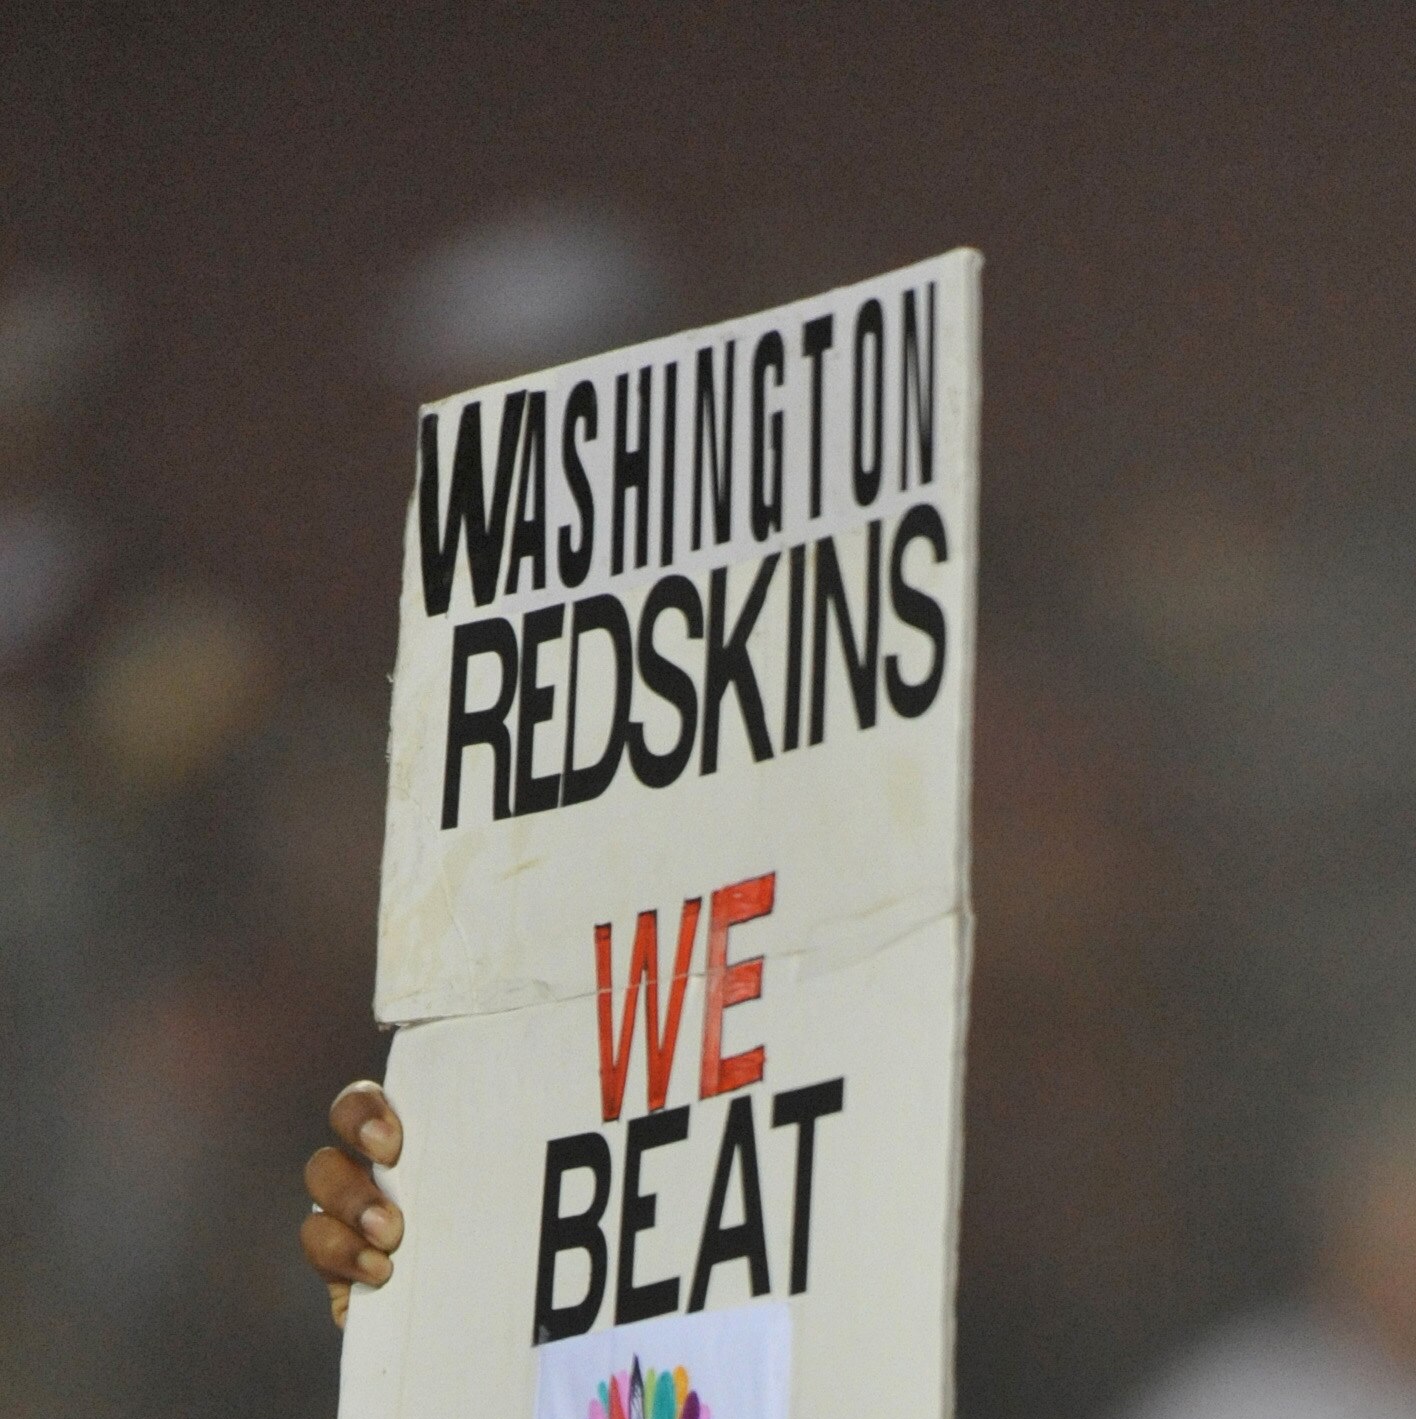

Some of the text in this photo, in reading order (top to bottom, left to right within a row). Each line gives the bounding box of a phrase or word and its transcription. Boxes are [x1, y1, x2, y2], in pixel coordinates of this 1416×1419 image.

[418, 281, 938, 617] WASHINGTON
[441, 503, 948, 831] REDSKINS
[595, 871, 776, 1122] WE
[532, 1076, 845, 1347] BEAT
